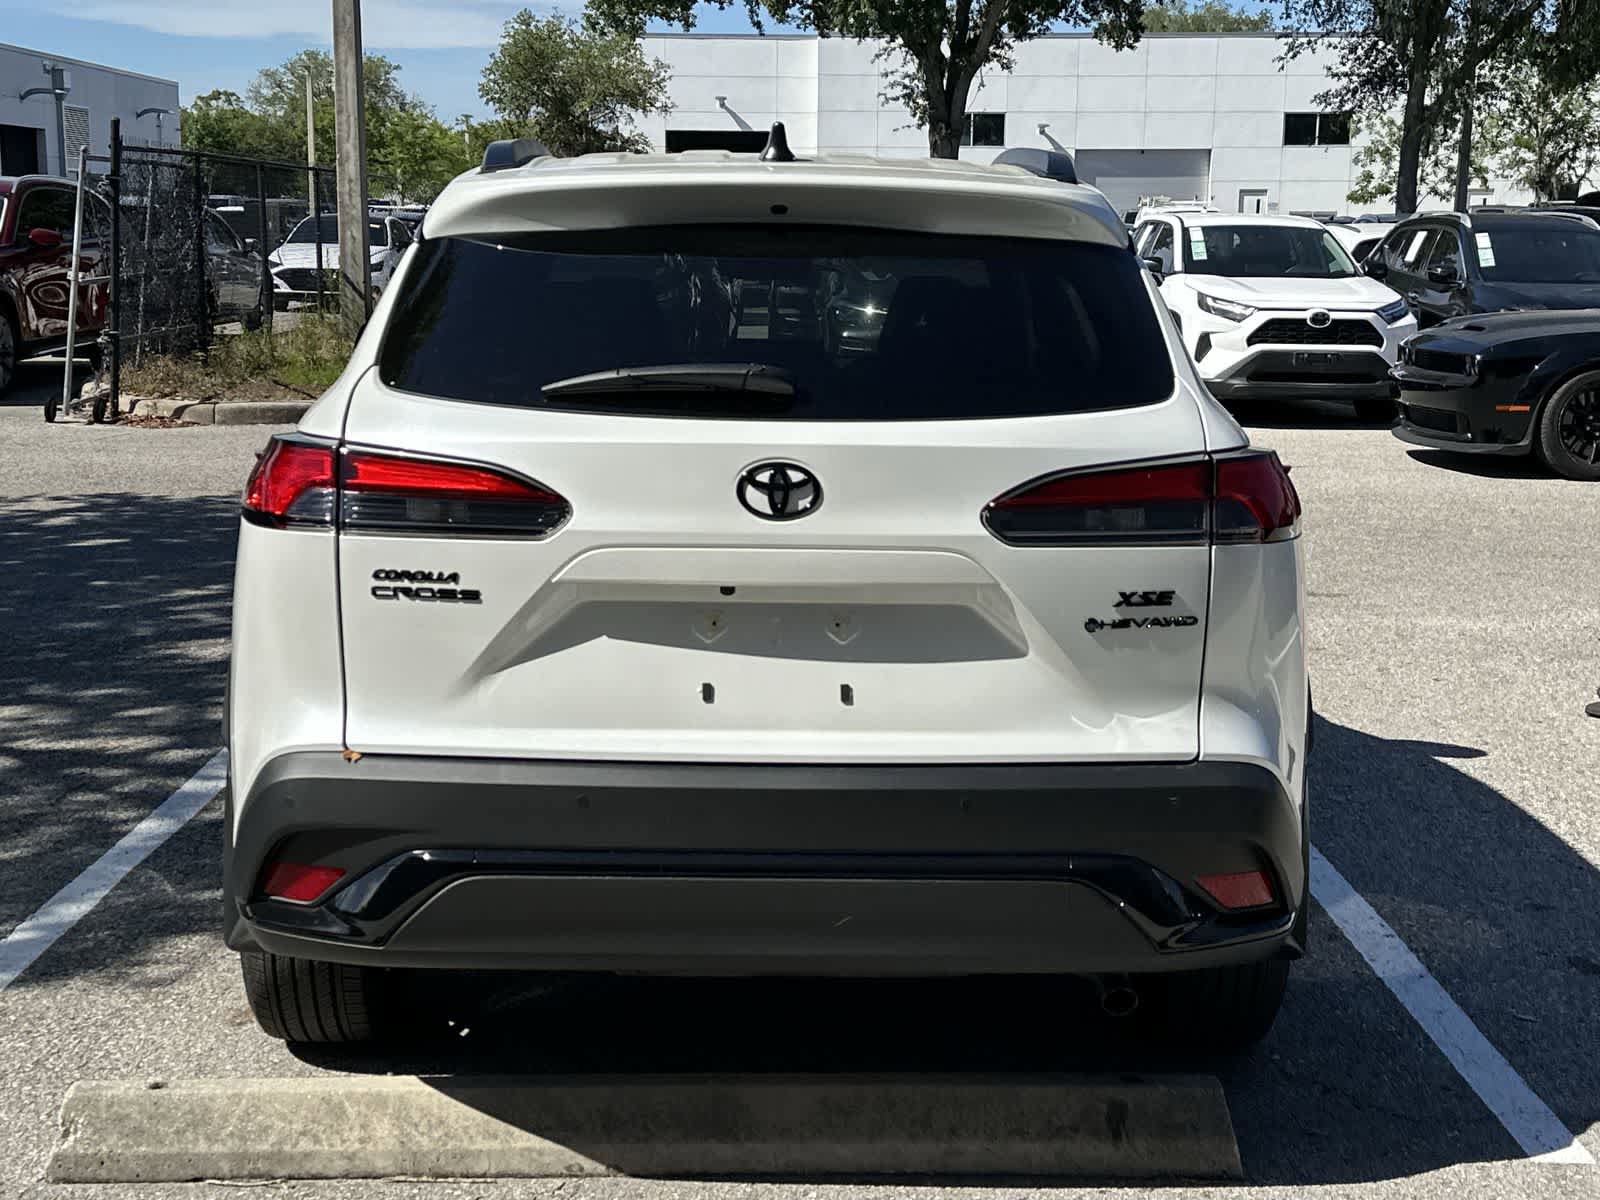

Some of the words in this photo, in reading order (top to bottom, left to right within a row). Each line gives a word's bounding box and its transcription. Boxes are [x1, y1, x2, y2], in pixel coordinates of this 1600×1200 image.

[372, 568, 460, 585] COROLLA
[371, 586, 482, 604] CROSS
[1112, 590, 1176, 607] XSE
